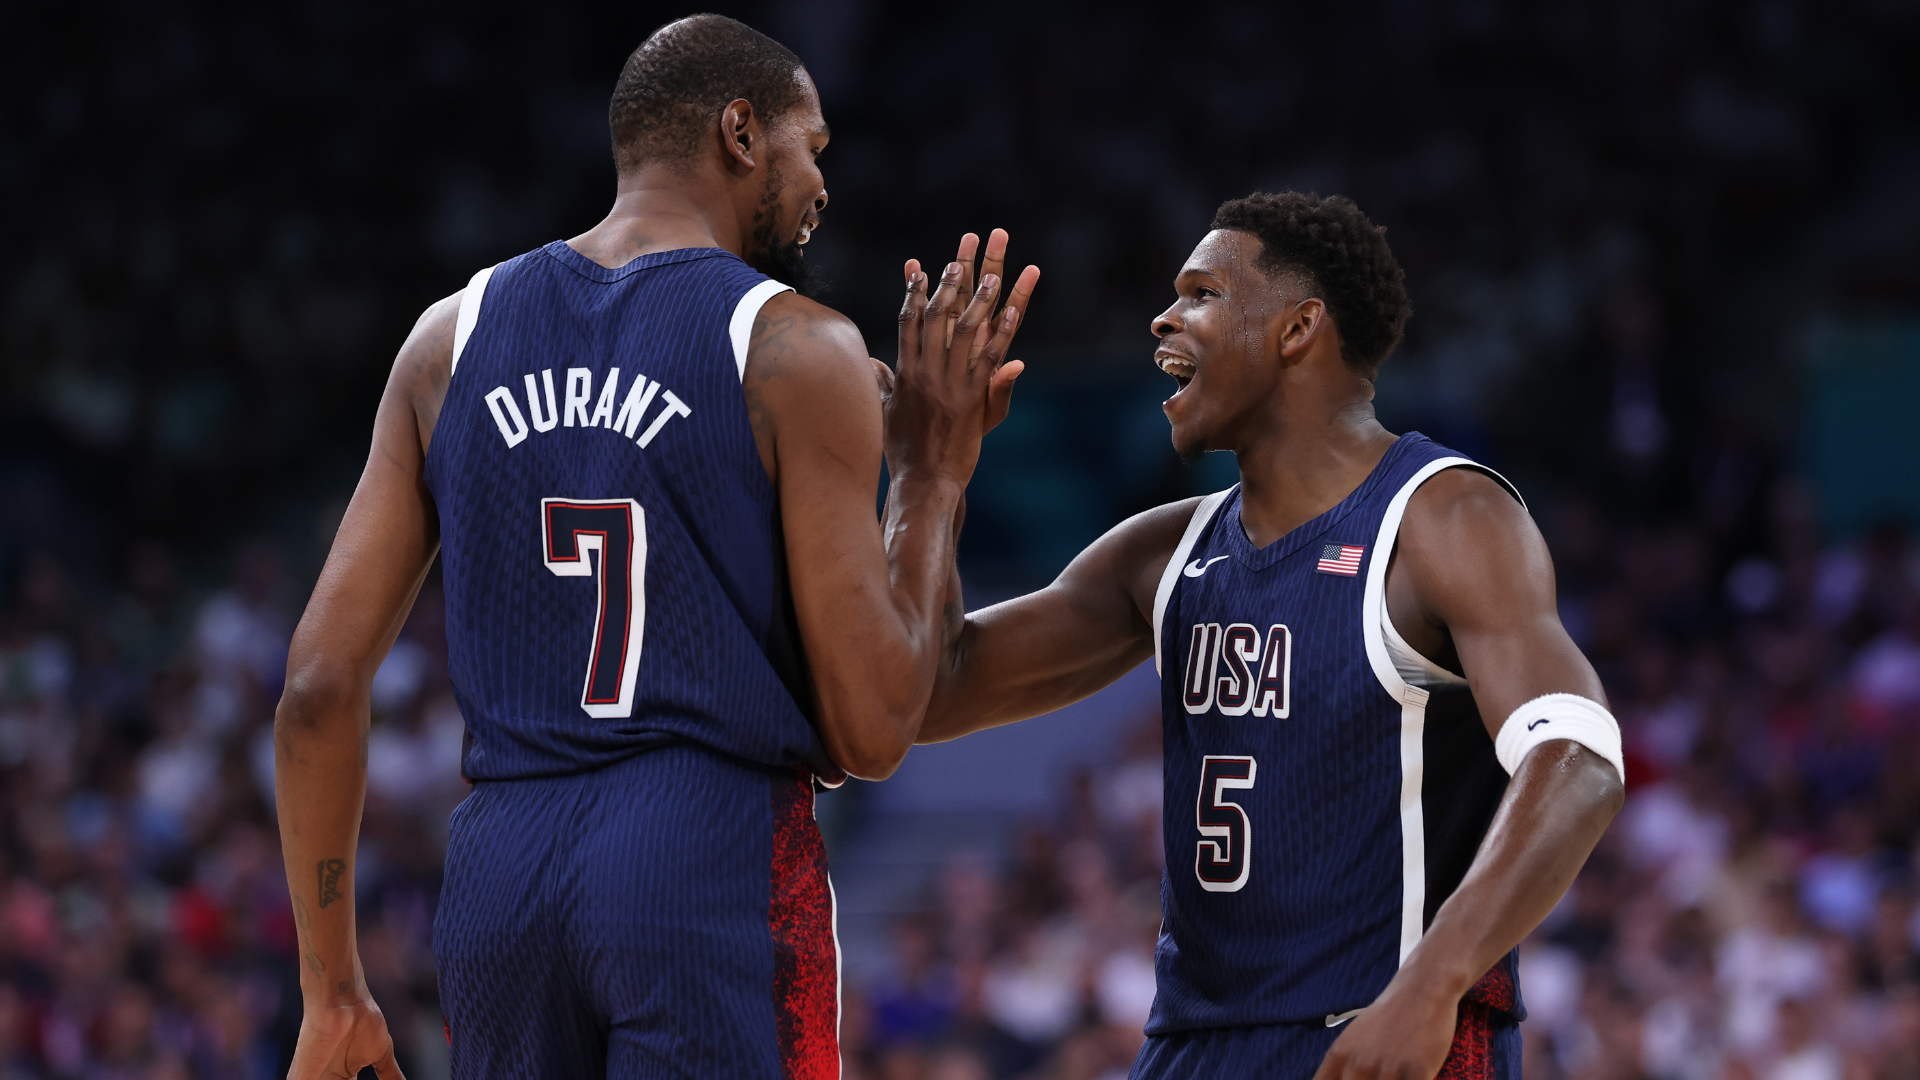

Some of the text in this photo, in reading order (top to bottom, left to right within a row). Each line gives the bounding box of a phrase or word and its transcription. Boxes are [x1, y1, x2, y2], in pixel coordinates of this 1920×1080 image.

[484, 367, 692, 449] DURANT
[541, 497, 647, 718] 7
[1183, 623, 1292, 719] USA
[1195, 755, 1257, 892] 5
